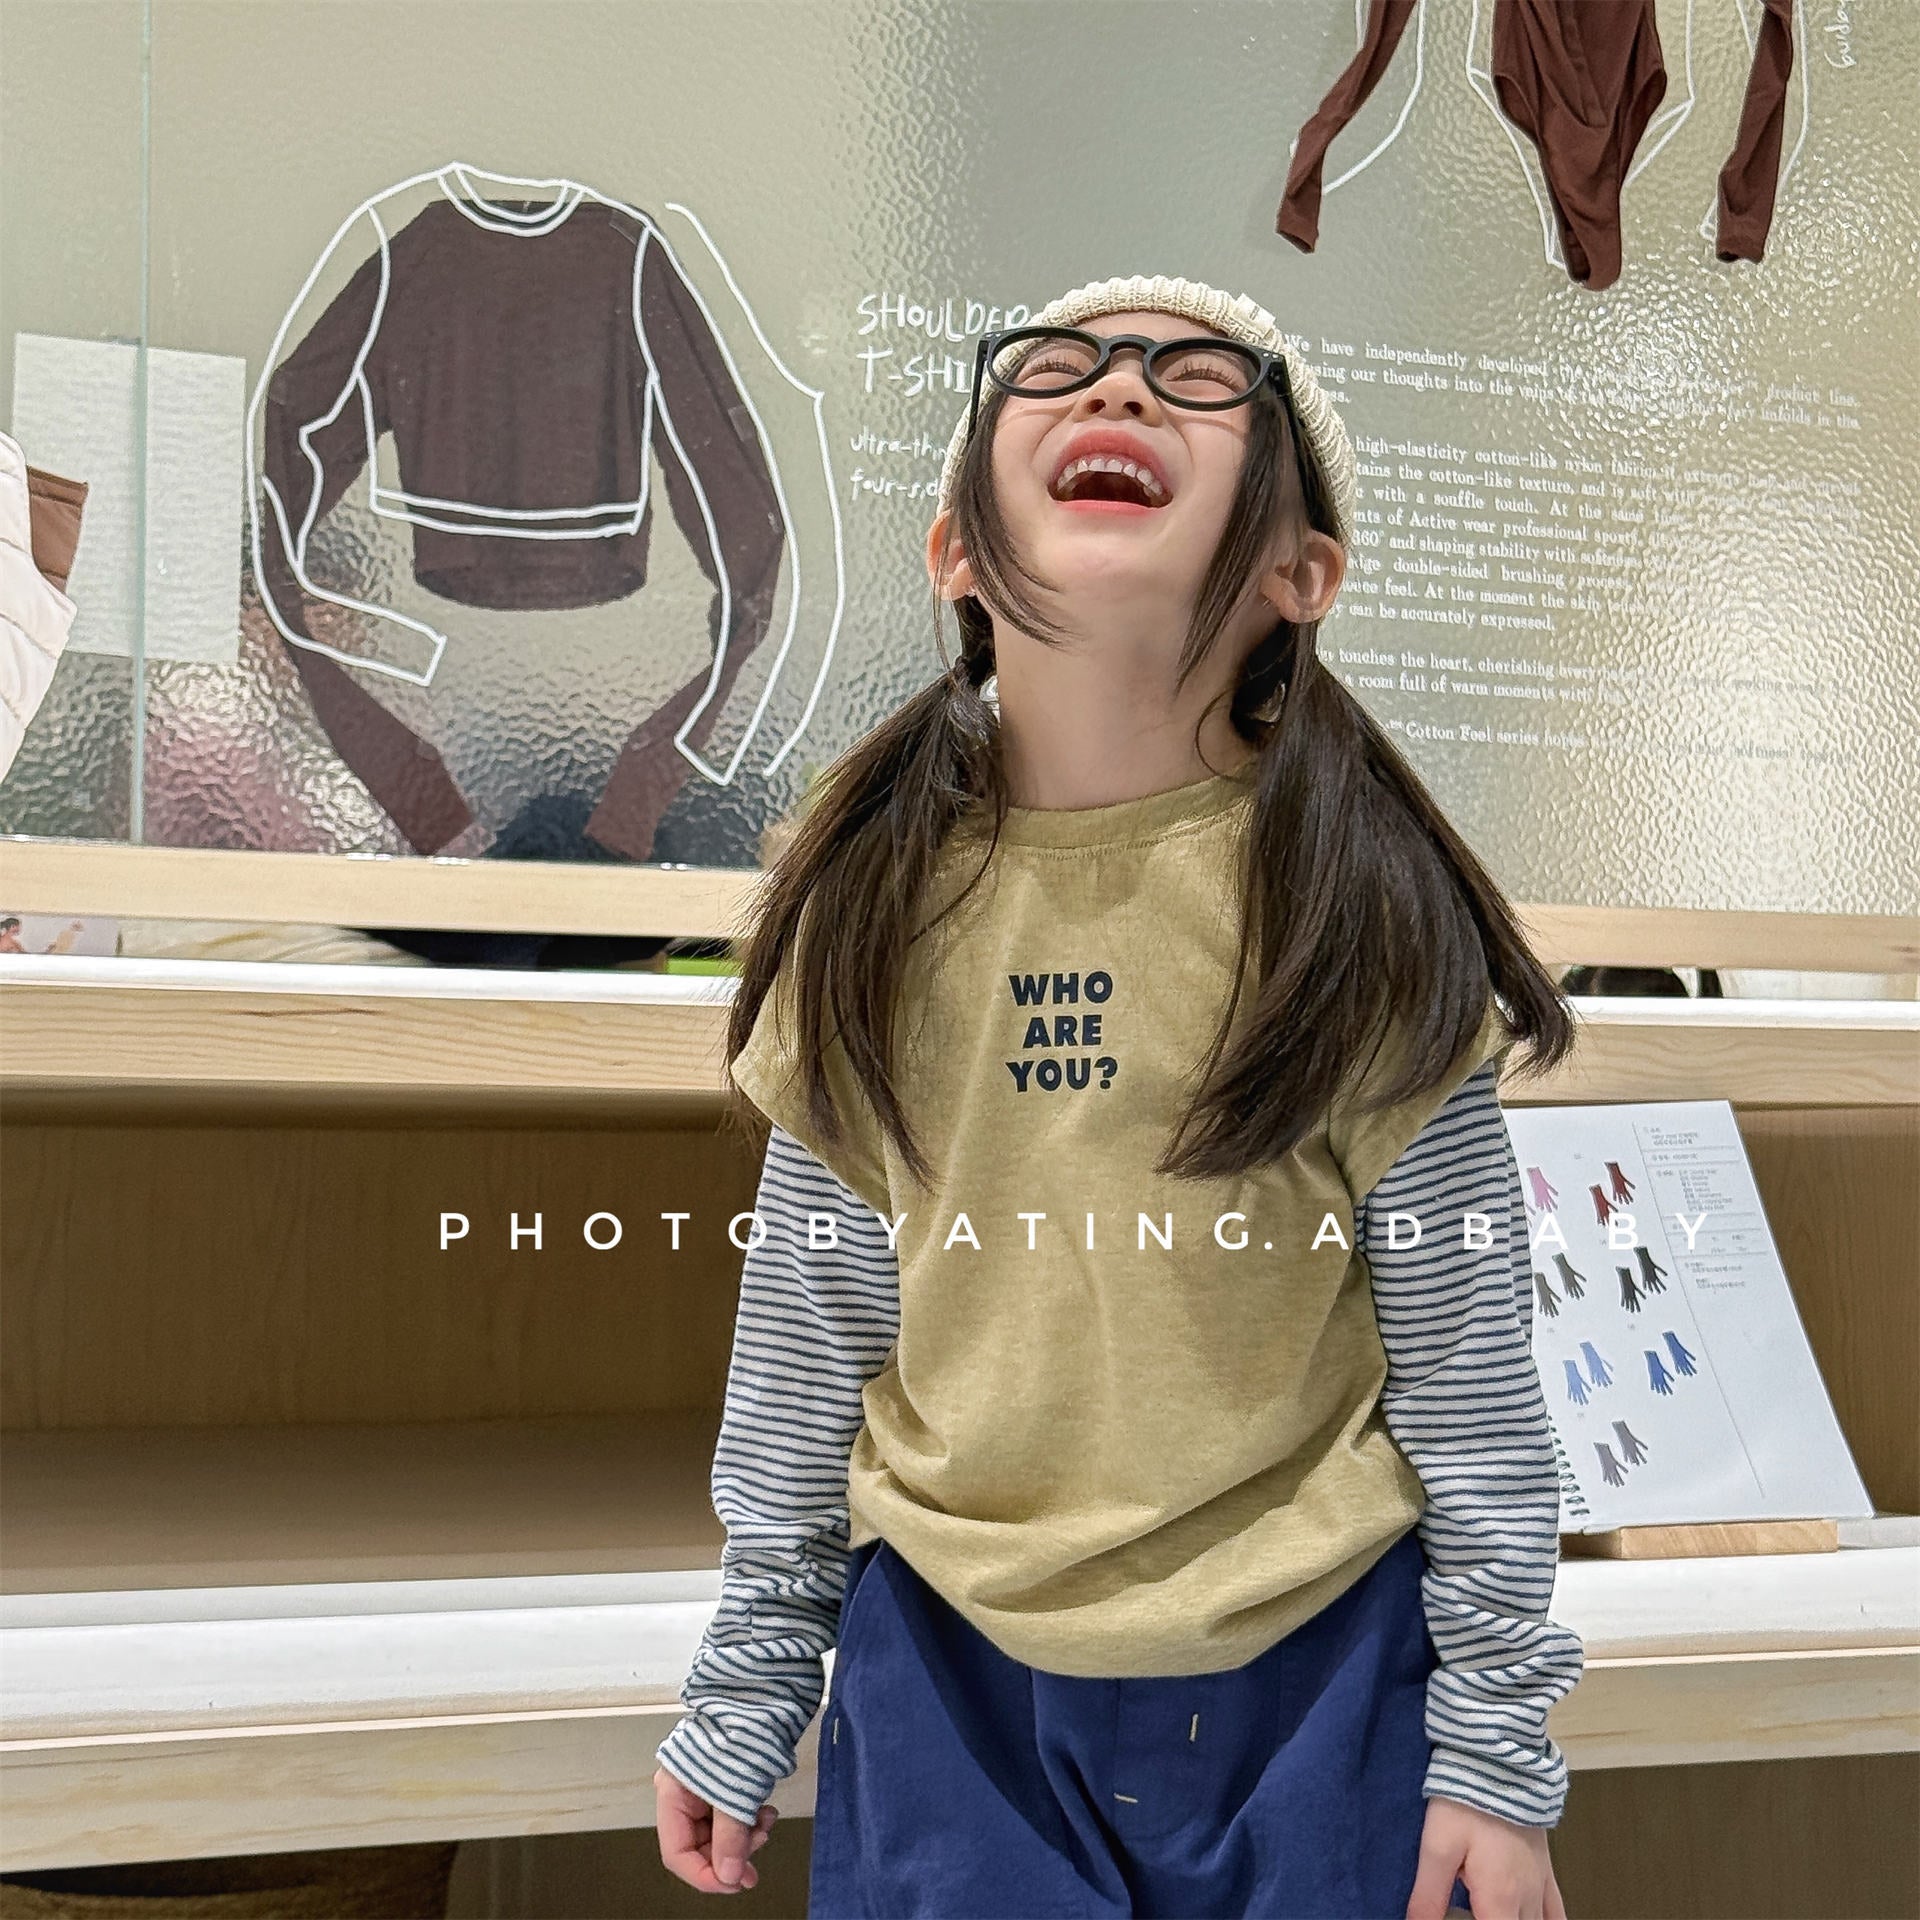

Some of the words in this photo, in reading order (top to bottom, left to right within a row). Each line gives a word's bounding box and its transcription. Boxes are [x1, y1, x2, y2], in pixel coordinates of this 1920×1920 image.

[1321, 338, 1354, 357] have
[1365, 341, 1467, 372] independently
[1351, 368, 1376, 383] our
[1382, 367, 1448, 394] thoughts
[1454, 375, 1484, 394] into
[1489, 377, 1514, 397] the
[1355, 435, 1468, 466] high-elasticity
[1474, 447, 1558, 472] cotton-like
[1355, 460, 1391, 480] tains
[1398, 464, 1424, 482] the
[1429, 465, 1512, 490] cotton-like
[1519, 475, 1575, 497] texture,
[1580, 478, 1606, 498] and
[1372, 483, 1406, 503] with
[1416, 492, 1425, 505] a
[1434, 486, 1484, 510] souffle
[1548, 499, 1569, 518] At
[1578, 502, 1602, 520] the
[1386, 506, 1404, 527] of
[1409, 510, 1457, 531] Active
[1462, 519, 1496, 534] wear
[1503, 517, 1589, 546] professional
[1389, 532, 1416, 551] and
[1418, 535, 1474, 560] shaping
[1478, 540, 1540, 565] stability
[1544, 547, 1576, 565] with
[1393, 554, 1488, 582] double-sided
[1500, 563, 1566, 591] brushing
[1384, 576, 1418, 598] feel.
[1424, 581, 1444, 600] At
[1450, 584, 1474, 602] the
[1480, 587, 1535, 607] moment
[1541, 590, 1565, 609] the
[1348, 605, 1374, 618] can
[1378, 602, 1396, 619] be
[1400, 602, 1475, 629] accurately
[1338, 646, 1395, 668] touches
[1400, 651, 1424, 669] the
[1478, 655, 1554, 682] cherishing
[1359, 676, 1394, 691] room
[1400, 669, 1426, 693] full
[1430, 672, 1448, 694] of
[1450, 681, 1488, 696] warm
[1406, 720, 1454, 742] Cotton
[1459, 722, 1492, 744] Feel
[1496, 726, 1539, 747] series
[1008, 971, 1113, 1006] WHO
[1022, 1014, 1103, 1049] ARE
[1005, 1056, 1119, 1093] YOU?
